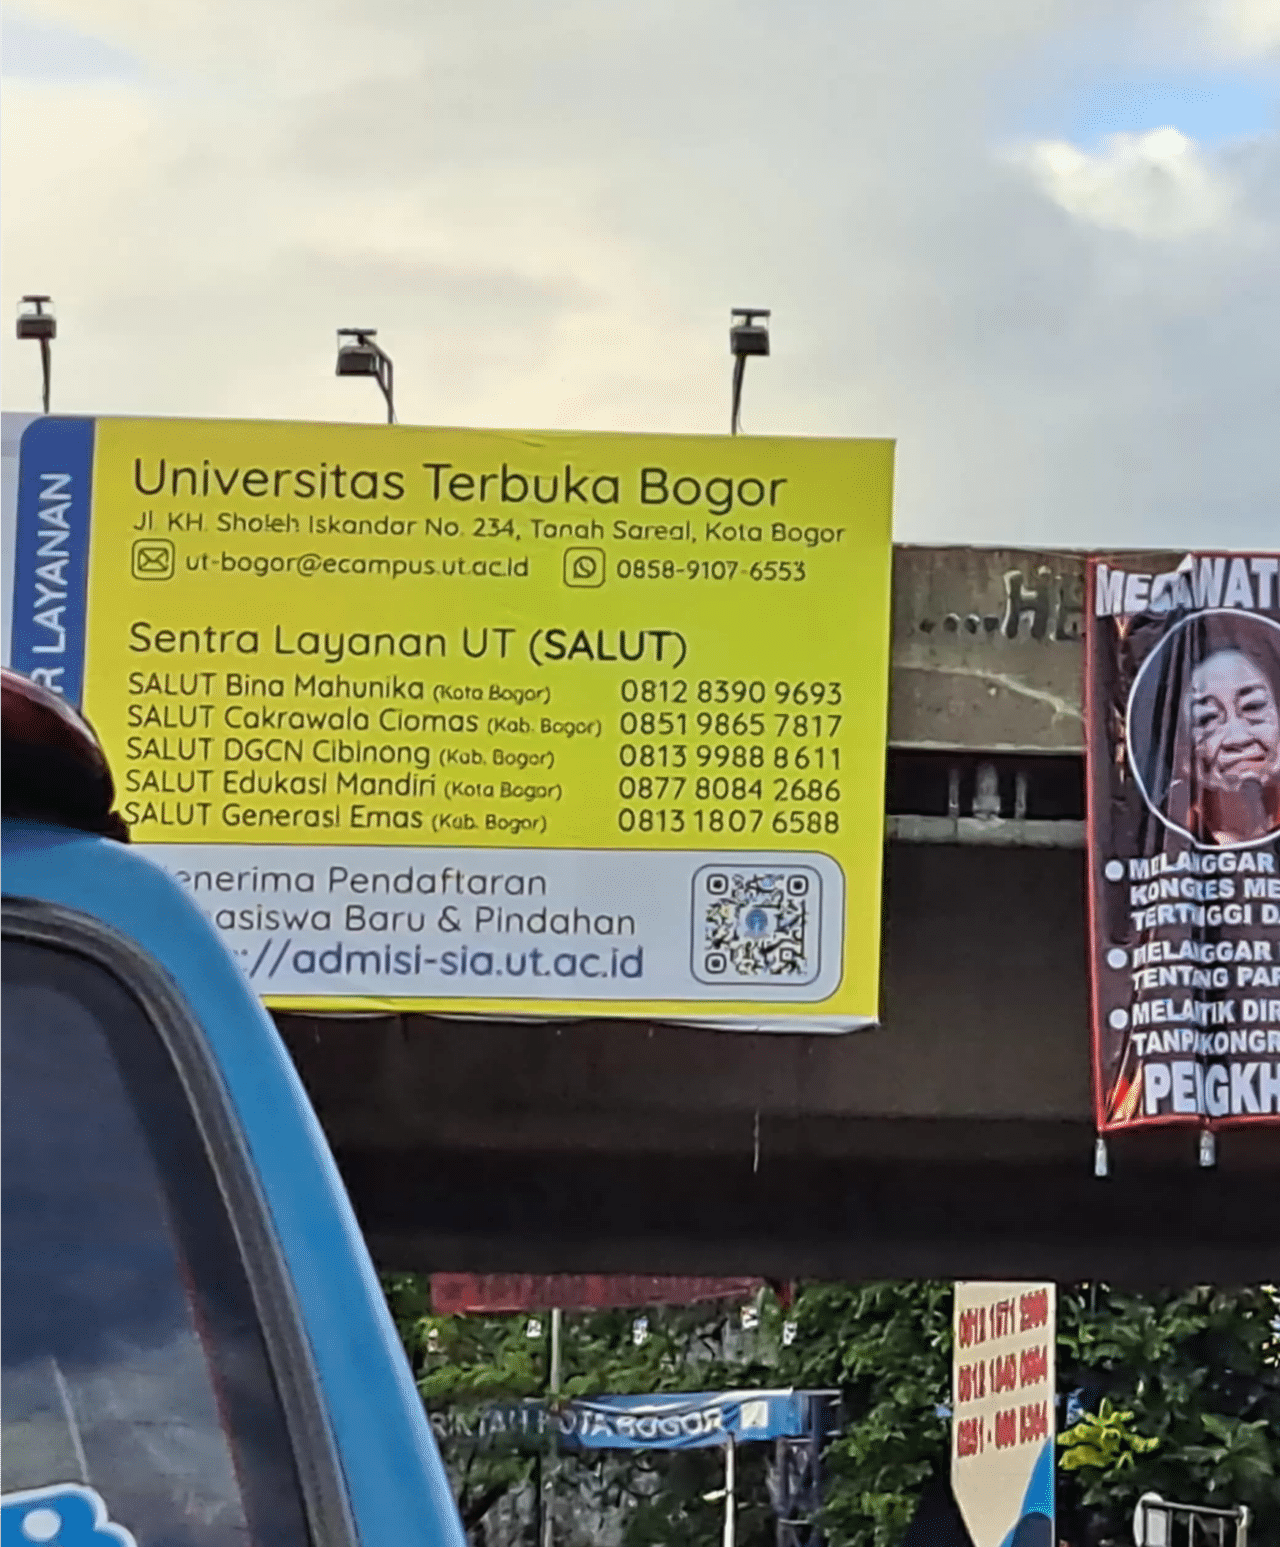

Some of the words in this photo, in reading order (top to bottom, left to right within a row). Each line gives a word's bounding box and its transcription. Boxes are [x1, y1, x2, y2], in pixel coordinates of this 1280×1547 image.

[134, 458, 405, 501] Universitas
[422, 462, 620, 503] Terbuka
[640, 467, 788, 516] Bogor
[216, 512, 300, 533] Sholeh
[309, 514, 417, 536] Iskandar
[472, 517, 522, 541] 234,
[530, 518, 604, 540] Tanah
[612, 520, 697, 543] Sareal,
[705, 522, 763, 543] Kota
[772, 523, 846, 548] Bogor
[32, 473, 73, 654] LAYANAN
[616, 559, 807, 583] 0858-9107-6553
[129, 622, 259, 653] Sentra
[275, 624, 446, 663] Layanan
[463, 627, 516, 658] UT
[528, 628, 688, 669] (SALUT)
[128, 672, 217, 696] SALUT
[225, 672, 285, 697] Bina
[294, 674, 424, 699] Mahunika
[433, 684, 484, 703] (Kota
[488, 685, 551, 705] Bogor)
[620, 679, 688, 703] 0812
[697, 680, 766, 704] 8390
[774, 681, 843, 705] 9693
[127, 704, 216, 728] SALUT
[224, 705, 370, 732] Cakrawala
[378, 707, 479, 733] Ciomas
[487, 717, 536, 735] (Kab.
[541, 718, 602, 738] Bogor)
[620, 712, 687, 736] 0851
[696, 712, 766, 737] 9865
[775, 714, 842, 738] 7817
[126, 736, 216, 762] SALUT
[224, 738, 303, 763] DGCN
[312, 739, 431, 769] Cibinong
[439, 748, 487, 767] (Kab.
[493, 750, 555, 770] Bogor)
[619, 744, 687, 768] 0813
[696, 745, 765, 769] 9988
[774, 746, 841, 771] 8611
[125, 769, 214, 794] SALUT
[223, 770, 327, 795] Edukasi
[336, 772, 437, 798] Mandiri
[444, 781, 494, 800] (Kota
[500, 782, 563, 802] Bogor)
[618, 776, 687, 800] 0877
[695, 777, 764, 801] 8084
[773, 778, 842, 802] 2686
[124, 801, 212, 826] SALUT
[222, 803, 340, 828] Generasi
[350, 805, 424, 830] Emas
[431, 814, 480, 833] (Kab.
[485, 814, 548, 834] Bogor)
[618, 808, 686, 833] 0813
[694, 809, 764, 833] 1807
[772, 810, 840, 835] 6588
[175, 865, 315, 893] enerima
[328, 865, 547, 896] Pendaftaran
[215, 904, 332, 932] asiswa
[344, 905, 426, 933] Baru
[437, 906, 462, 933] &
[475, 906, 637, 936] Pindahan
[234, 938, 645, 980] ://admisi-sia.ut.ac.id
[1131, 1028, 1200, 1057] TANP
